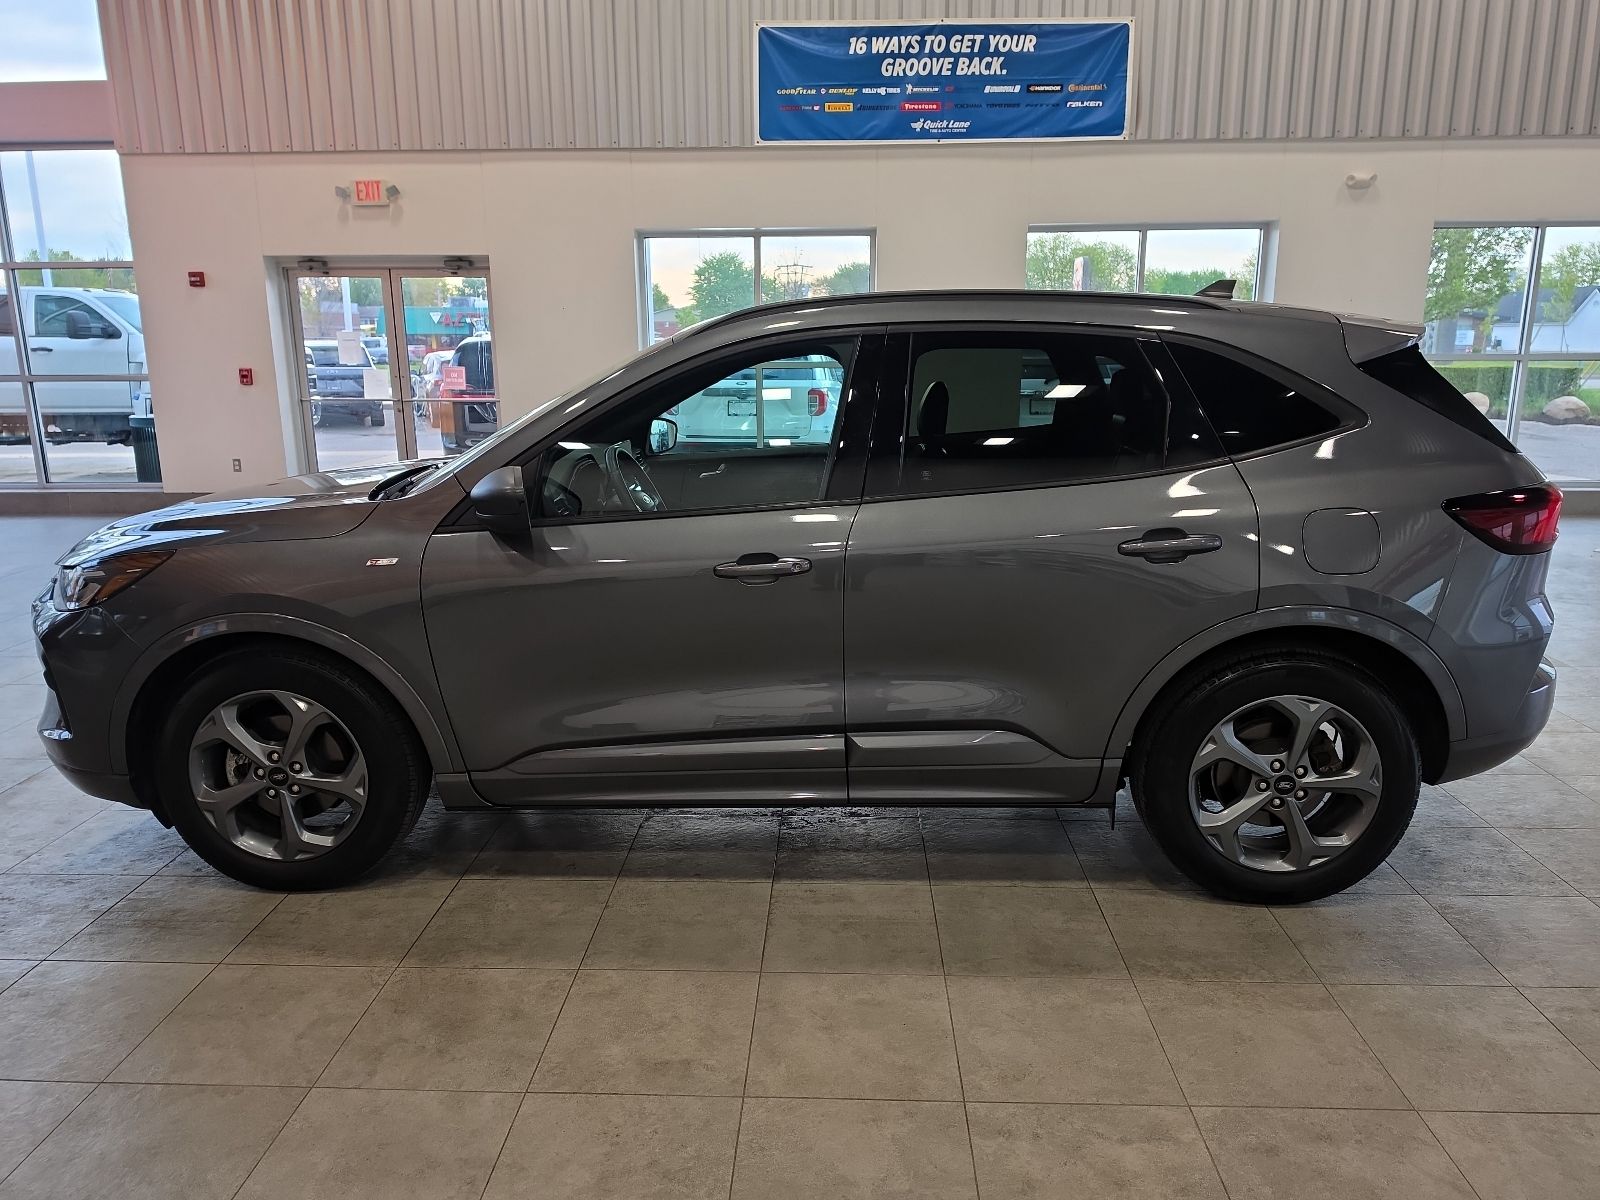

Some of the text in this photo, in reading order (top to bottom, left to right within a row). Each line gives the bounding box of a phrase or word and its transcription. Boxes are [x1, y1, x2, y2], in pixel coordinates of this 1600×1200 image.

[849, 34, 1037, 54] 16 WAYS TO GET YOUR
[881, 57, 1008, 76] GROOVE BACK.
[777, 87, 817, 95] GOODYEAR
[1068, 84, 1103, 92] Continental
[924, 120, 970, 129] Quick Lane
[356, 181, 382, 201] EXIT
